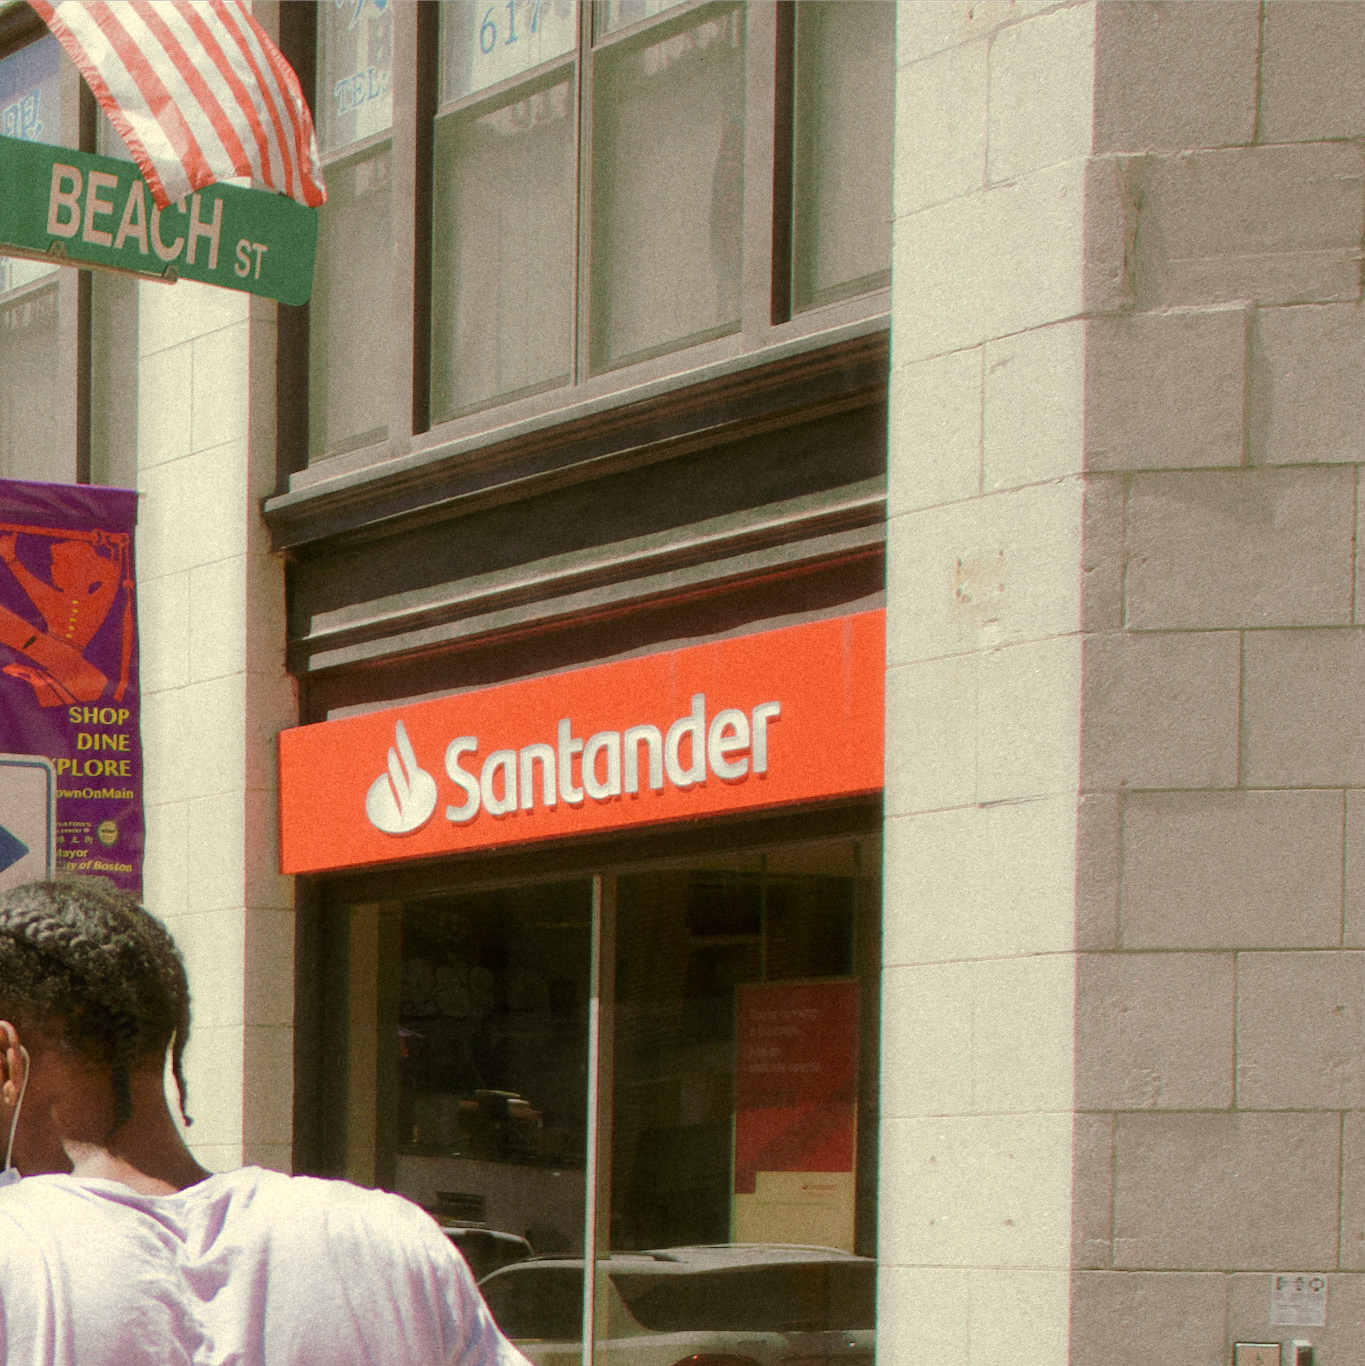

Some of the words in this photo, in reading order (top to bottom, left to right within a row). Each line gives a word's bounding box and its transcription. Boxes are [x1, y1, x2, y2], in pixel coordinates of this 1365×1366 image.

[46, 162, 223, 270] BEACH
[234, 238, 268, 279] ST
[69, 706, 130, 726] SHOP
[77, 732, 131, 751] DINE
[51, 758, 133, 777] PLORE
[444, 693, 781, 824] Santander
[56, 788, 134, 800] ownOnMain
[78, 859, 93, 871] of
[93, 861, 133, 873] Boston
